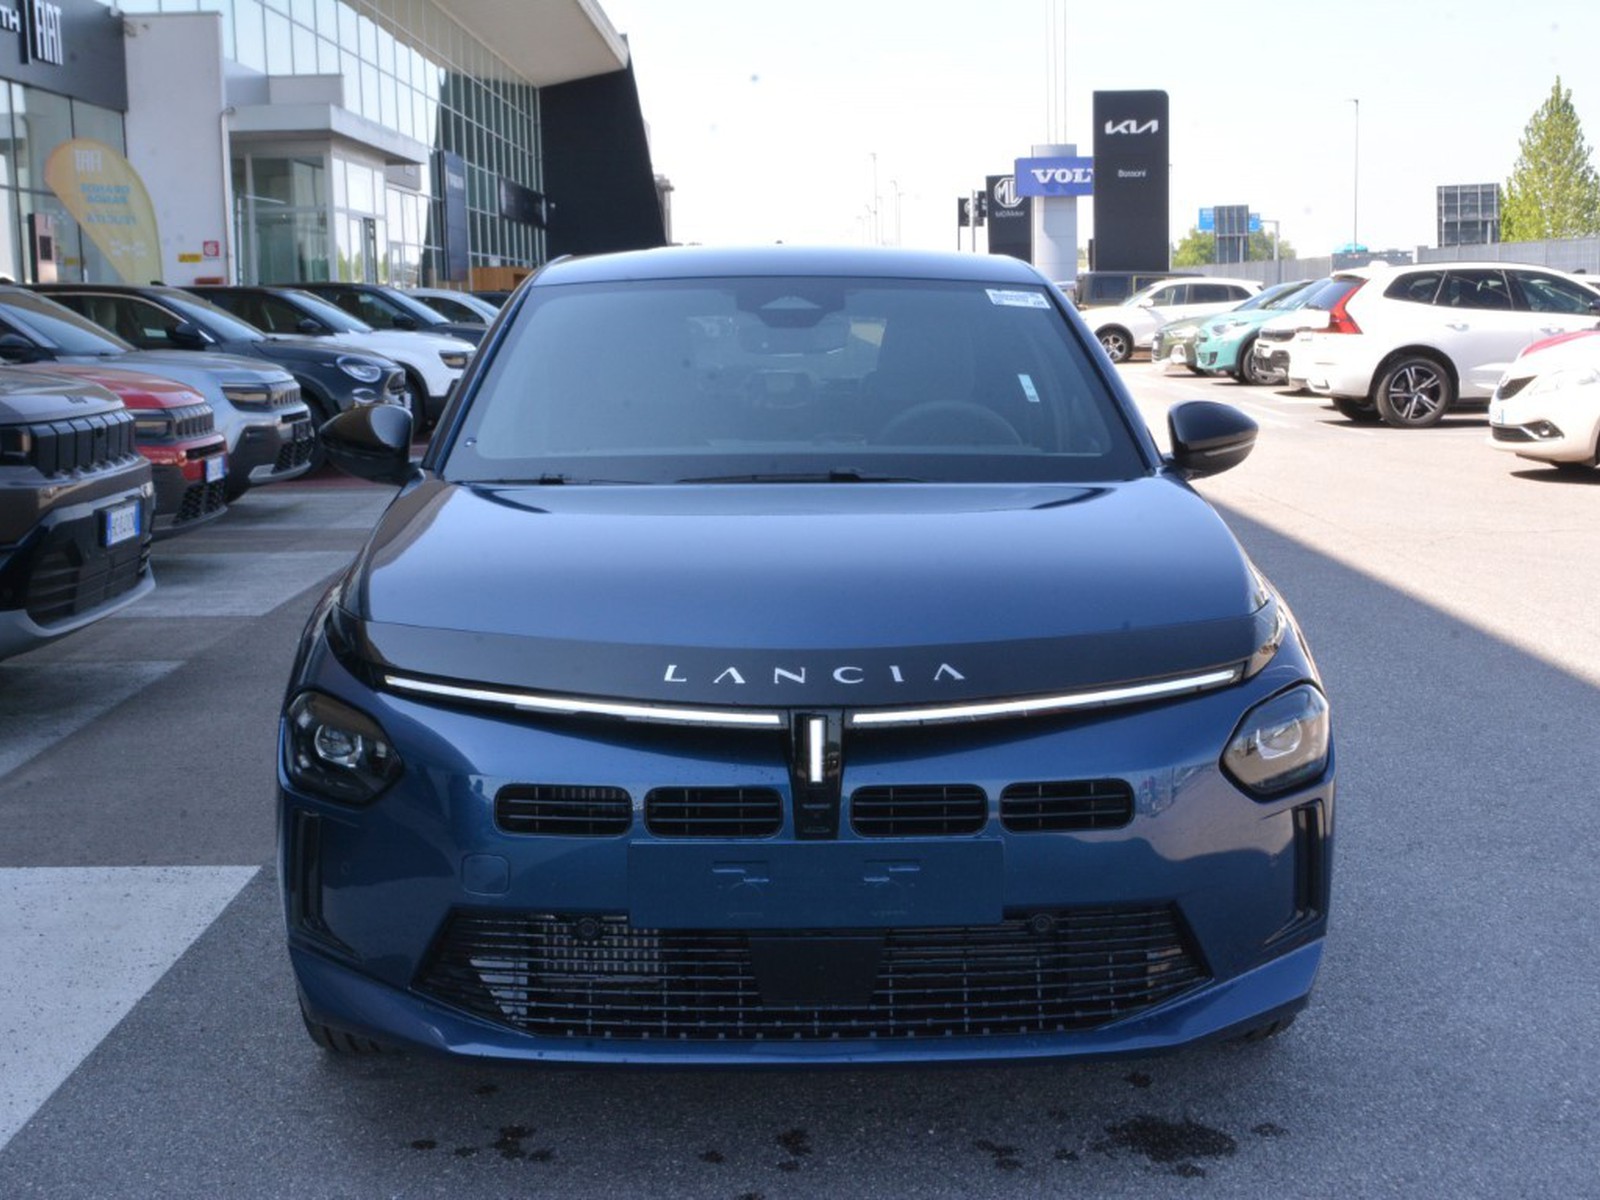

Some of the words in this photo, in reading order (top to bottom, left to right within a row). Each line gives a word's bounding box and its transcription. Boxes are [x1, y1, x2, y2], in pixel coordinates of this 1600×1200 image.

[34, 0, 63, 65] FIAT
[1105, 119, 1159, 134] KIA
[1031, 168, 1093, 184] VOL
[664, 663, 965, 684] LANCIA
